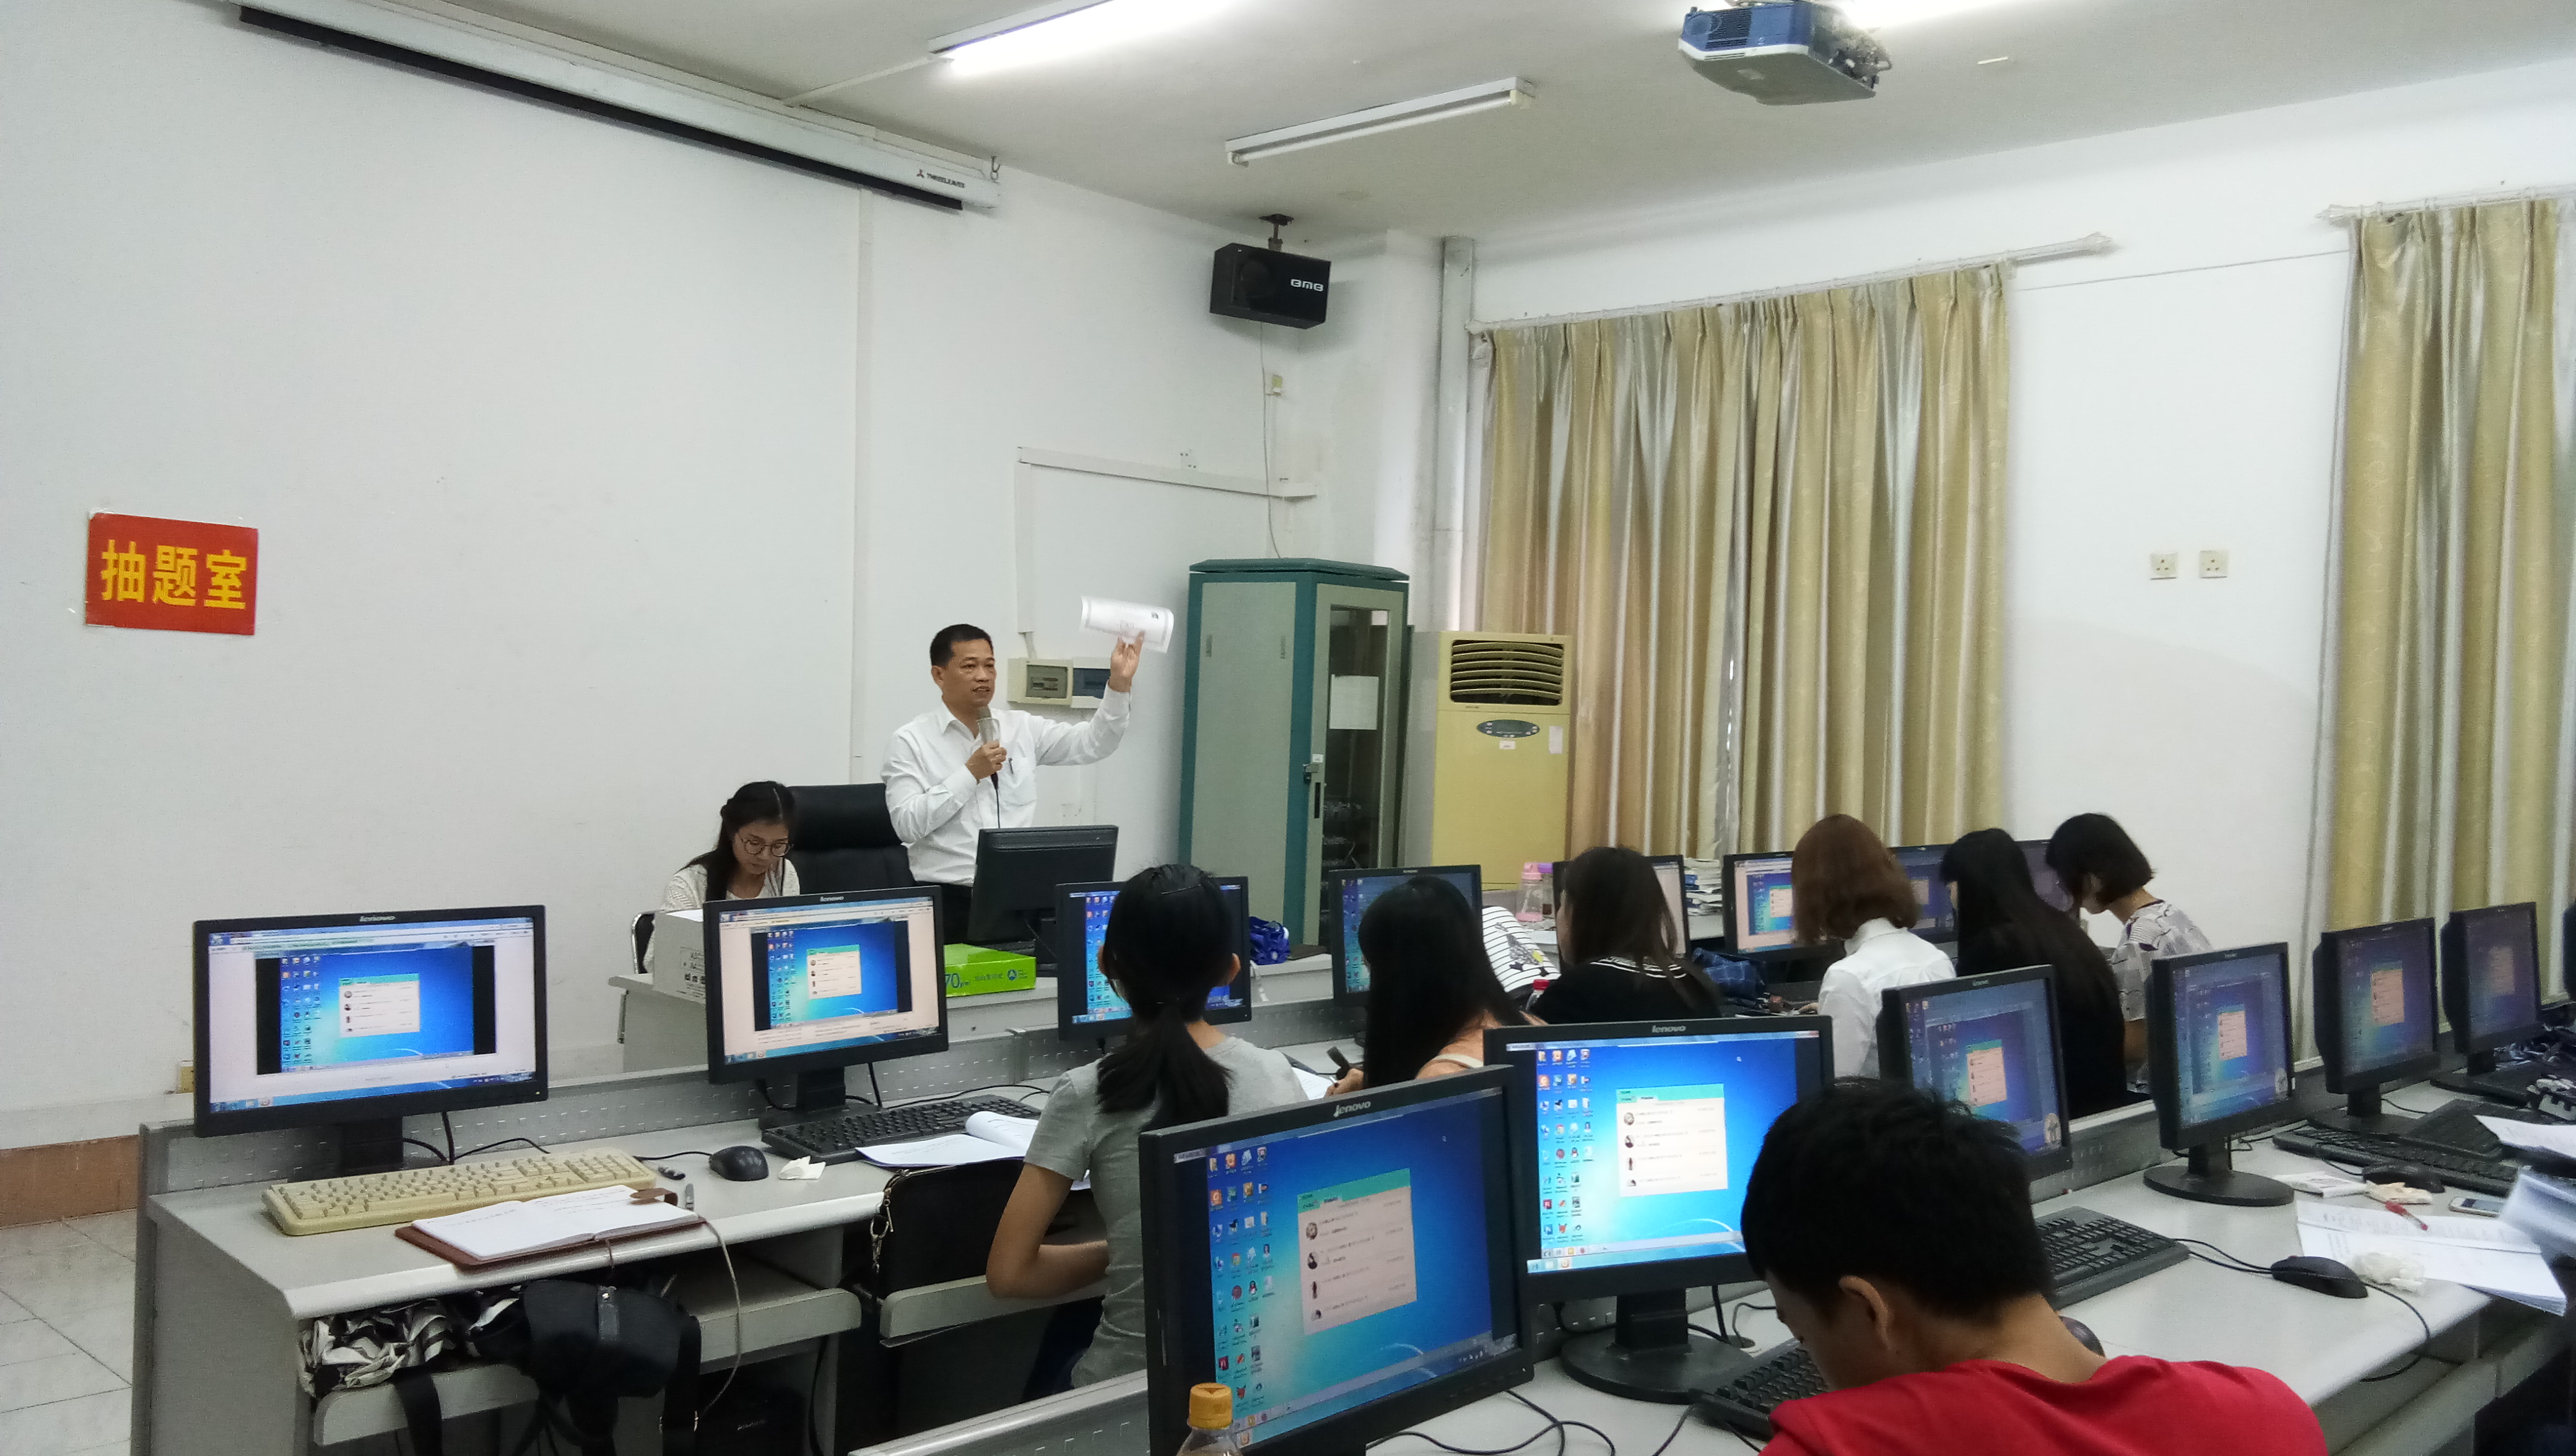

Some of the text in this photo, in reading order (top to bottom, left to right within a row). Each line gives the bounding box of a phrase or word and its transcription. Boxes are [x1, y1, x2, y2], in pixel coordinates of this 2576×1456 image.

[100, 539, 247, 610] 抽题室
[1651, 1025, 1686, 1033] lenovo
[1333, 1101, 1372, 1117] lenovo
